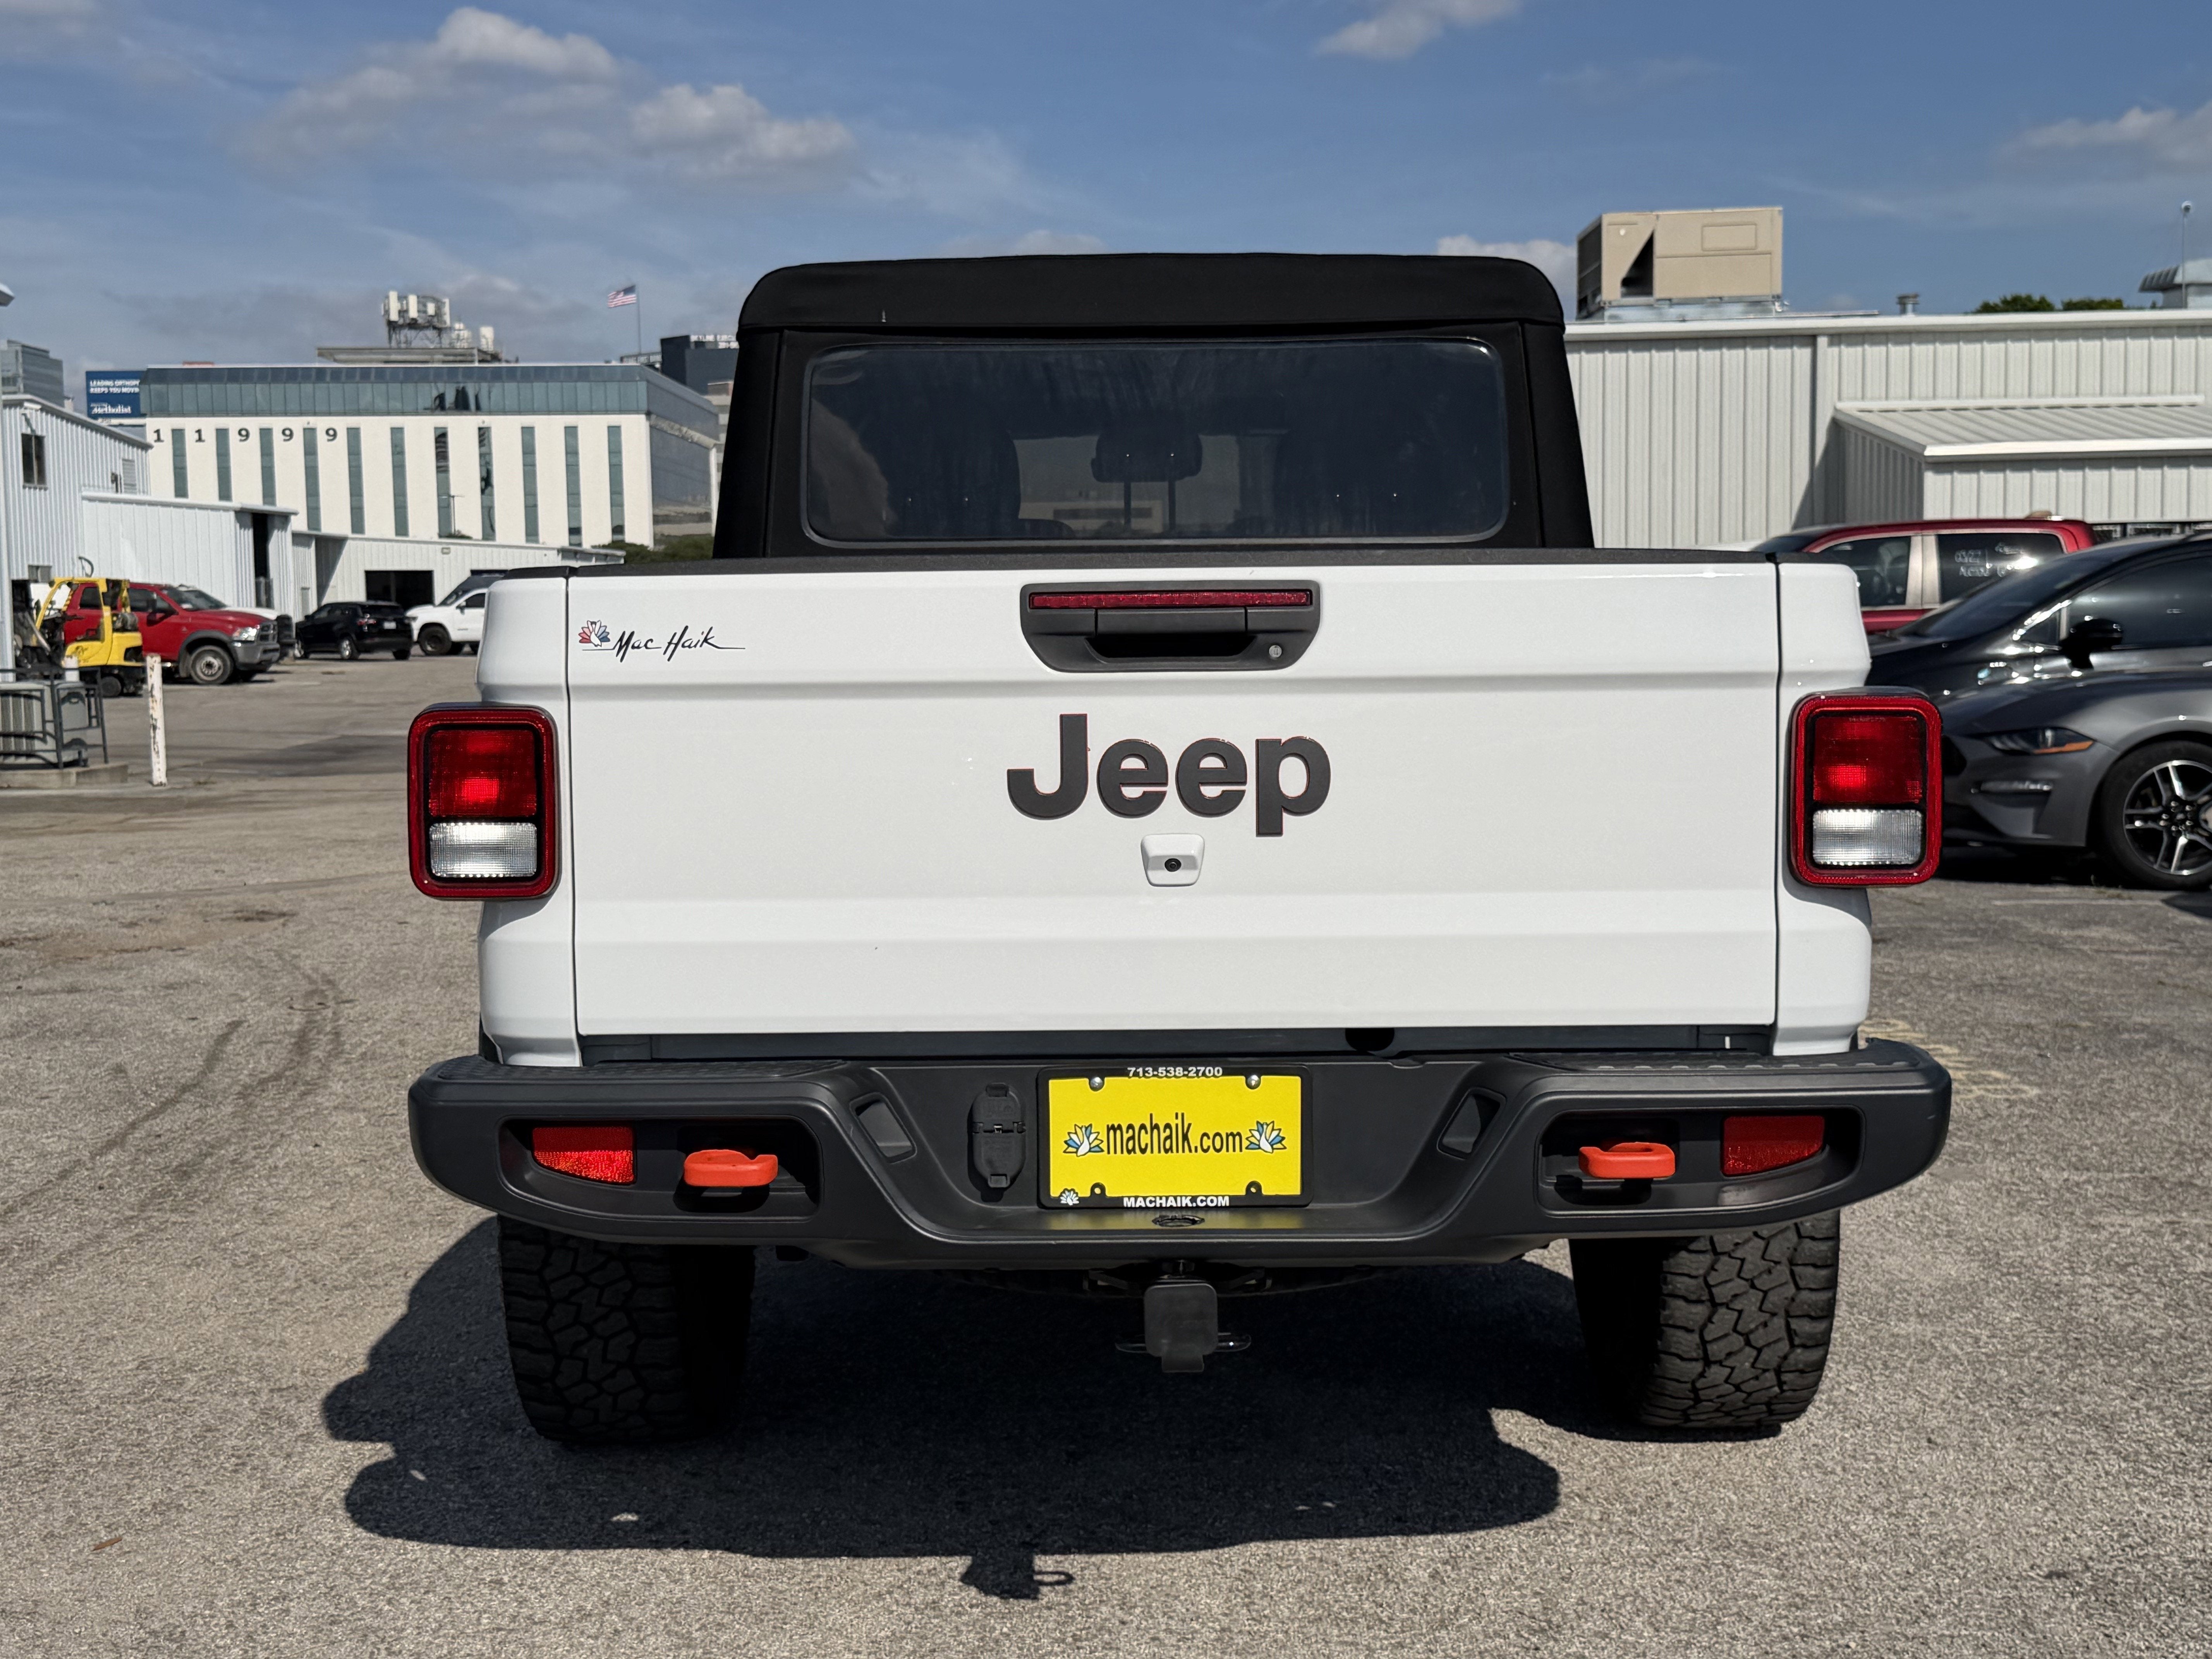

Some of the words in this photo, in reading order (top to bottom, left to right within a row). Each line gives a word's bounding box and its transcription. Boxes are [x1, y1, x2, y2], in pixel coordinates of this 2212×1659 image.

[612, 630, 661, 663] Mac
[663, 625, 745, 662] Haik
[1007, 713, 1331, 837] Jeep
[1127, 1066, 1223, 1077] 713-538-2700
[1106, 1112, 1243, 1155] machaik.com
[1123, 1195, 1230, 1207] MACHAIK.COM
